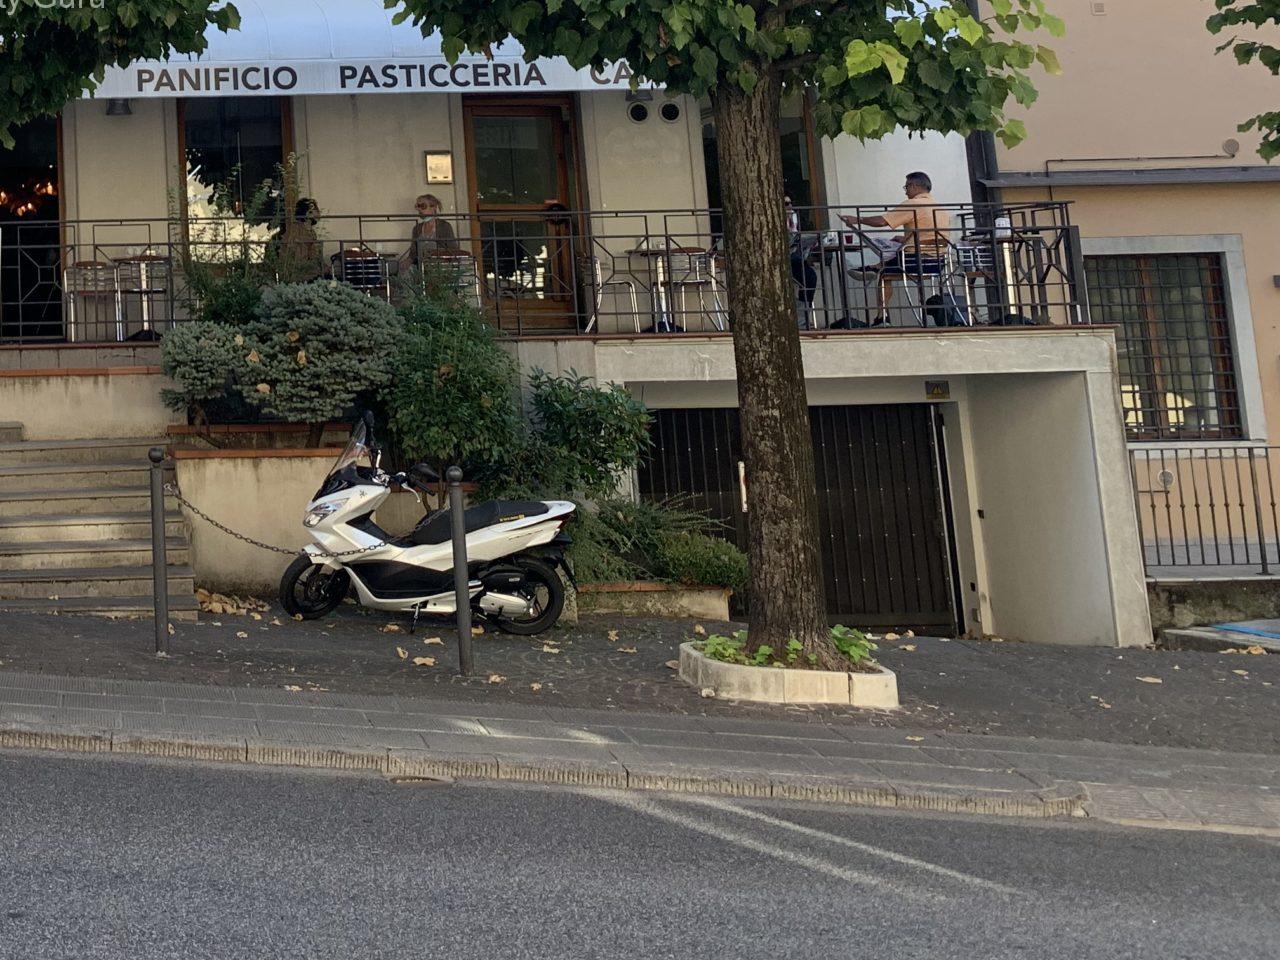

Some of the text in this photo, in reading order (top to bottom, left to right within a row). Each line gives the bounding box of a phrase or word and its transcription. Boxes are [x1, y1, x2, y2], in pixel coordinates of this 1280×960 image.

[137, 60, 645, 92] PANIFICIO PASTICCERIA CA
